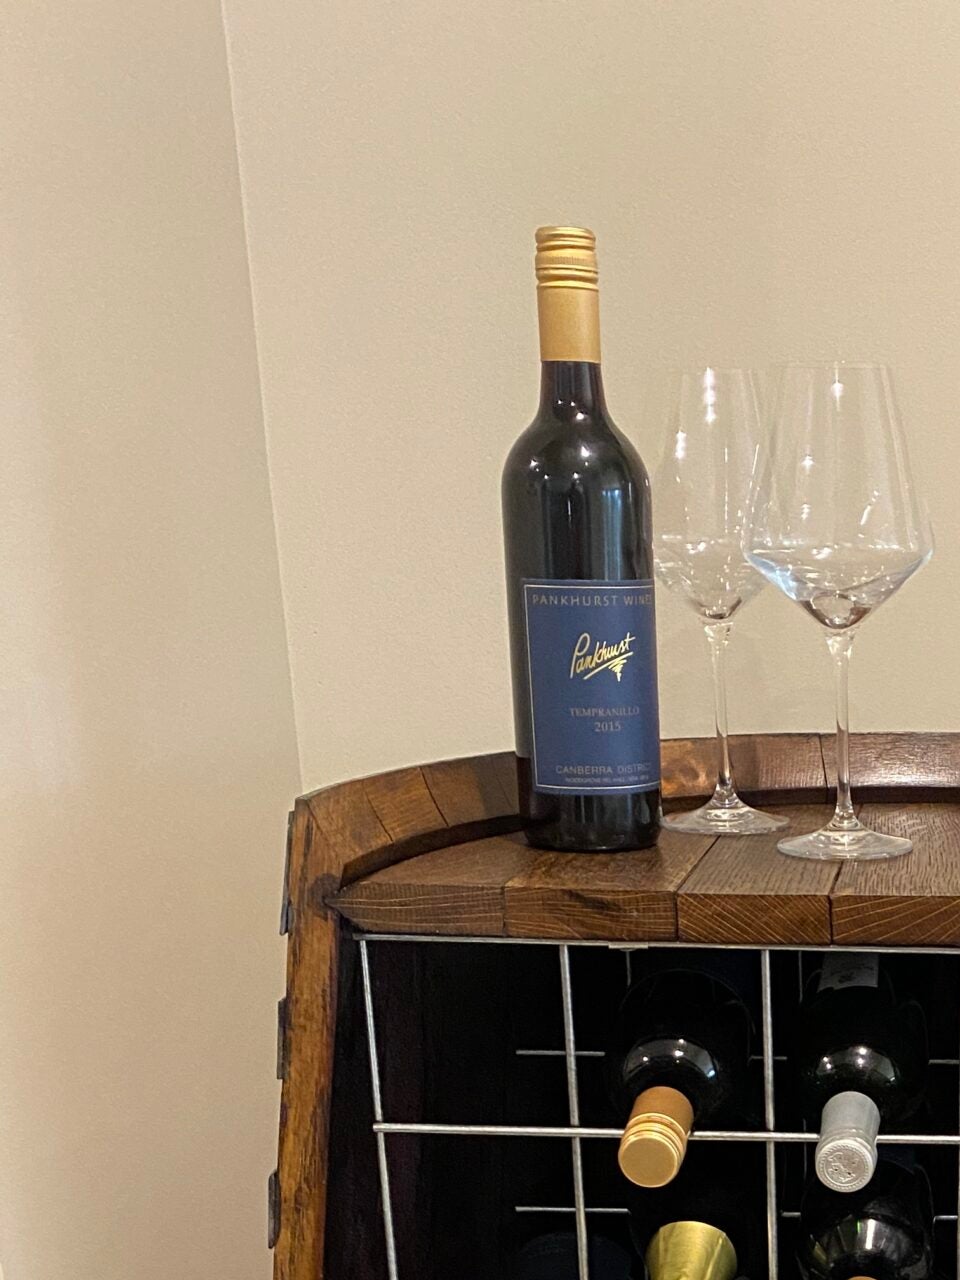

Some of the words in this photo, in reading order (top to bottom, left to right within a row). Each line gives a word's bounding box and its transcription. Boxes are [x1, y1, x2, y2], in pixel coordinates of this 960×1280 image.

[532, 594, 619, 607] PANKHURST
[569, 632, 636, 679] Pankhurst
[570, 706, 640, 717] TEMPRANILLO
[594, 721, 621, 732] 2015
[555, 764, 613, 775] CANBERRA
